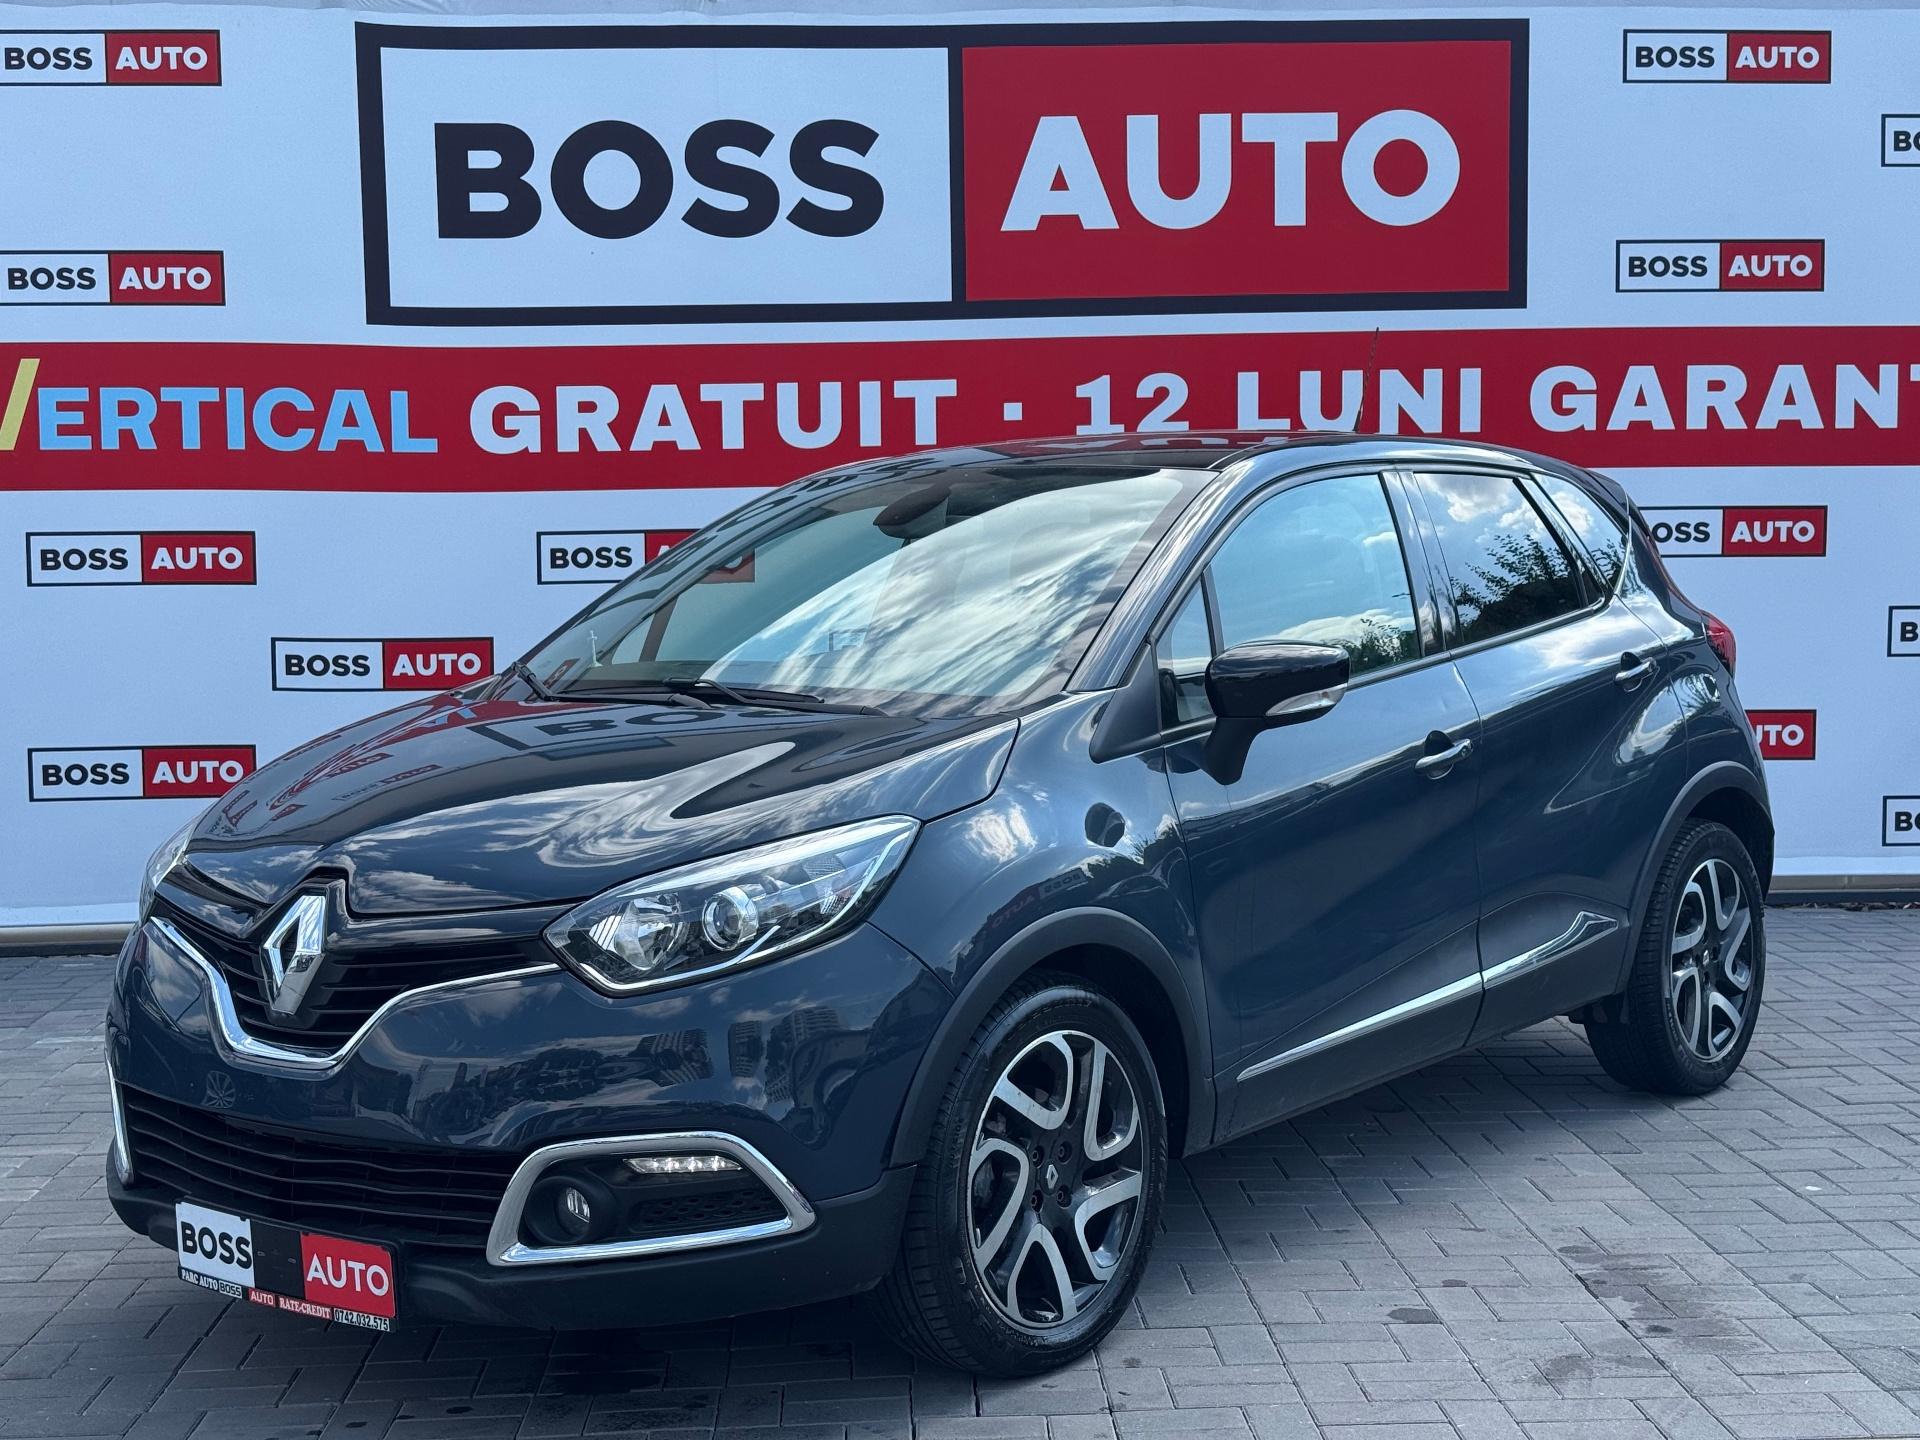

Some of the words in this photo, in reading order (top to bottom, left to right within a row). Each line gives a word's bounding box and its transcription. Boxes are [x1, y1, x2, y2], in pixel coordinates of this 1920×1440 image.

[5, 48, 92, 70] BOSS
[115, 47, 207, 70] AUTO
[1636, 47, 1714, 68] BOSS
[1735, 46, 1819, 68] AUTO
[435, 120, 884, 239] BOSS
[1001, 110, 1460, 231] AUTO
[1628, 256, 1707, 277] BOSS
[1729, 255, 1812, 277] AUTO
[7, 268, 96, 290] BOSS
[119, 267, 211, 290] AUTO
[470, 379, 957, 454] GRATUIT
[1076, 372, 1189, 435] 12
[1237, 368, 1481, 433] LUNI
[1731, 521, 1815, 543] AUTO
[41, 547, 128, 571] BOSS
[151, 546, 243, 570] AUTO
[550, 546, 632, 569] BOSS
[285, 653, 370, 677] BOSS
[393, 653, 481, 676] AUTO
[42, 762, 129, 786] BOSS
[153, 761, 243, 784] AUTO
[181, 1221, 252, 1269] BOSS
[307, 1253, 389, 1297] AUTO
[181, 1269, 199, 1285] PARC
[199, 1275, 219, 1291] AUTO
[219, 1283, 242, 1297] BOSS
[249, 1290, 275, 1305] AUTO
[333, 1308, 390, 1331] 0742.032.575
